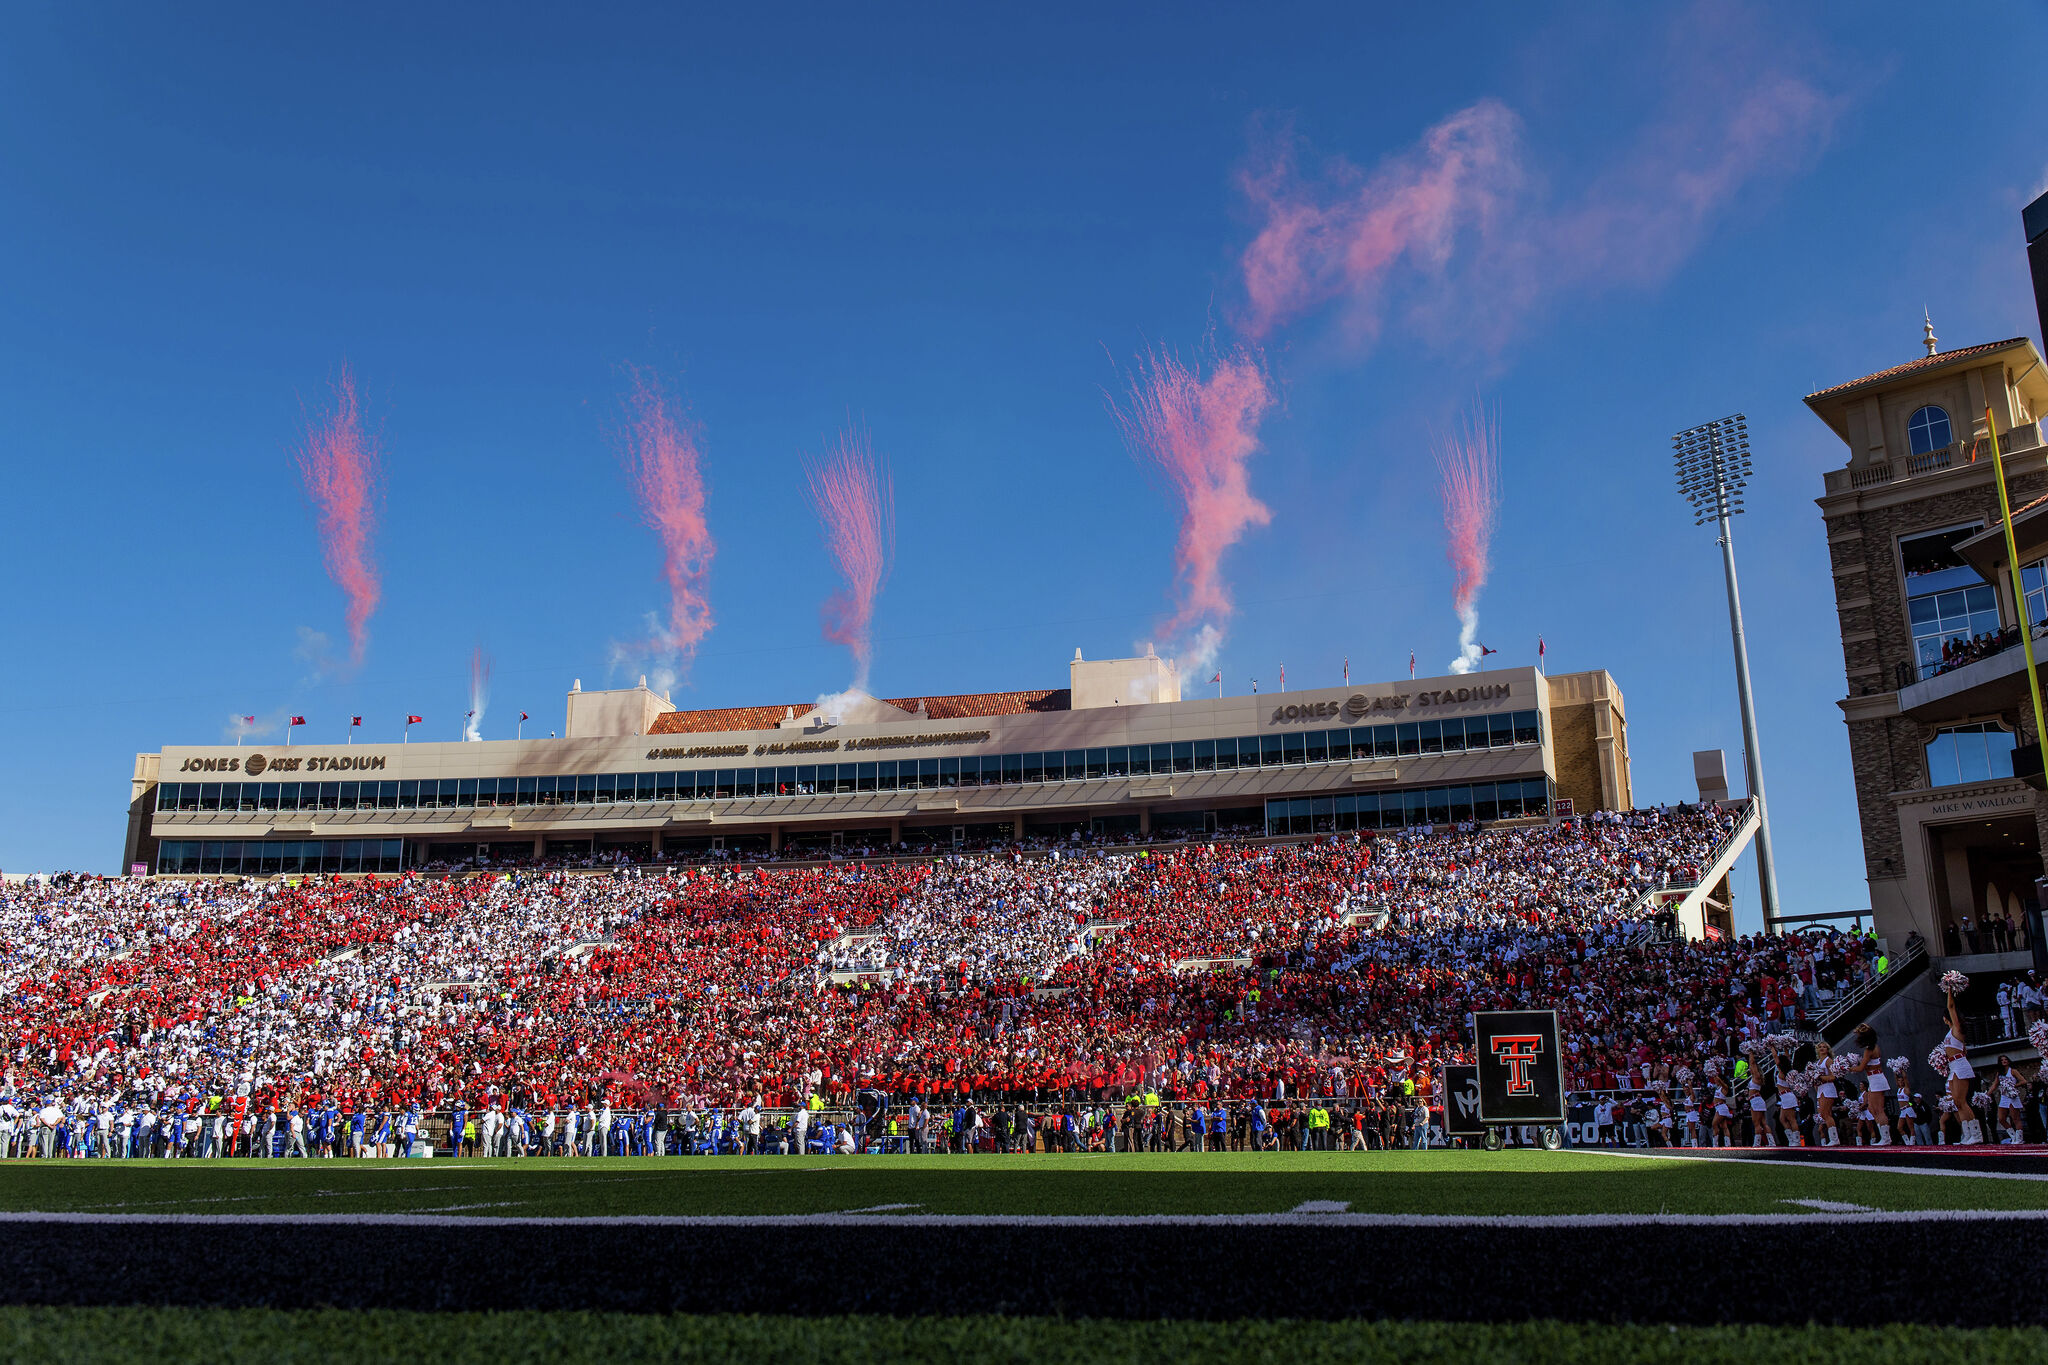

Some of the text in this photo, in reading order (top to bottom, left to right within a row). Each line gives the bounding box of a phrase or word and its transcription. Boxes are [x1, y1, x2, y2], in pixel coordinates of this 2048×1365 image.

[1274, 683, 1511, 721] JONES AT&T STADIUM
[859, 735, 915, 748] CONFERENCE
[916, 730, 991, 744] CHAMPIONSHIPS
[662, 747, 687, 758] BOWL
[688, 744, 749, 757] APPEARANCES
[180, 755, 387, 772] JONES AT&T STADIUM
[1557, 802, 1571, 810] 122
[1932, 795, 2027, 815] MIKE W. WALLACE
